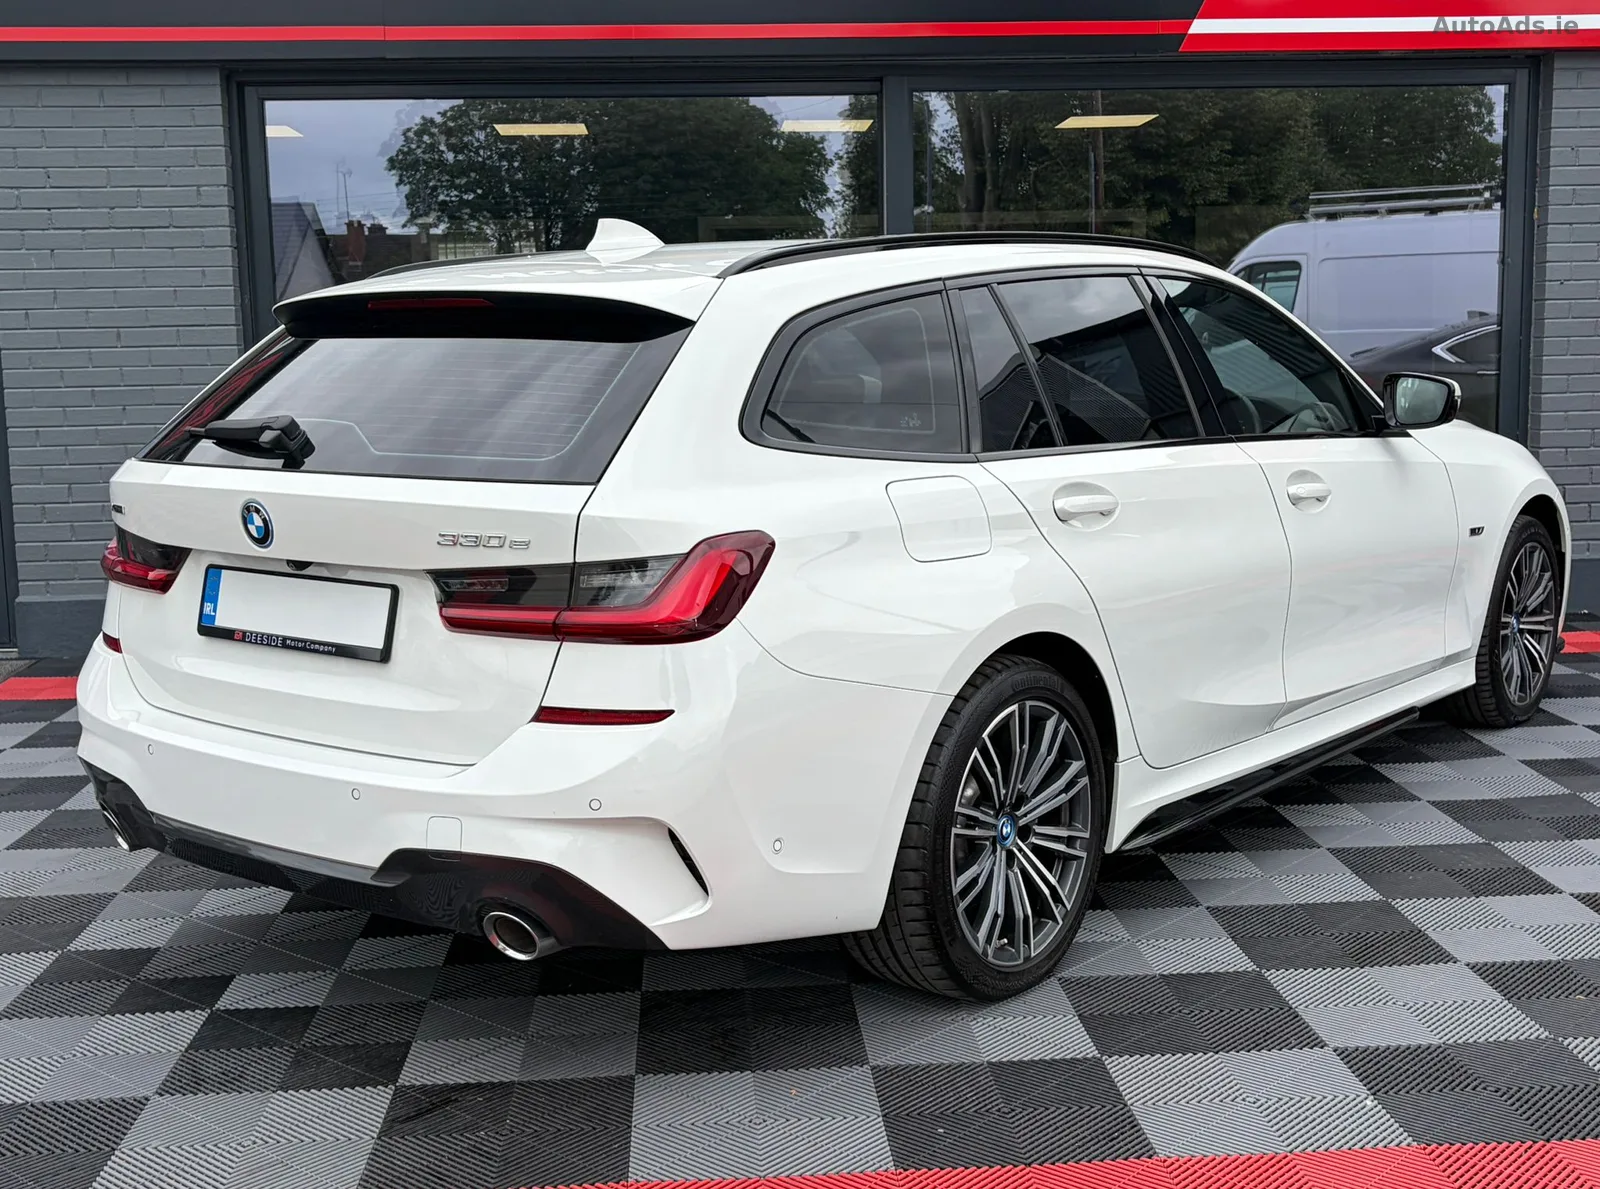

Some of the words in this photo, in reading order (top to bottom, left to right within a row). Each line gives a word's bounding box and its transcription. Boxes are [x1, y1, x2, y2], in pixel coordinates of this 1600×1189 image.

[203, 601, 216, 616] IRL
[245, 632, 283, 647] DEESIDE
[286, 639, 305, 648] Motor
[305, 642, 336, 653] Company
